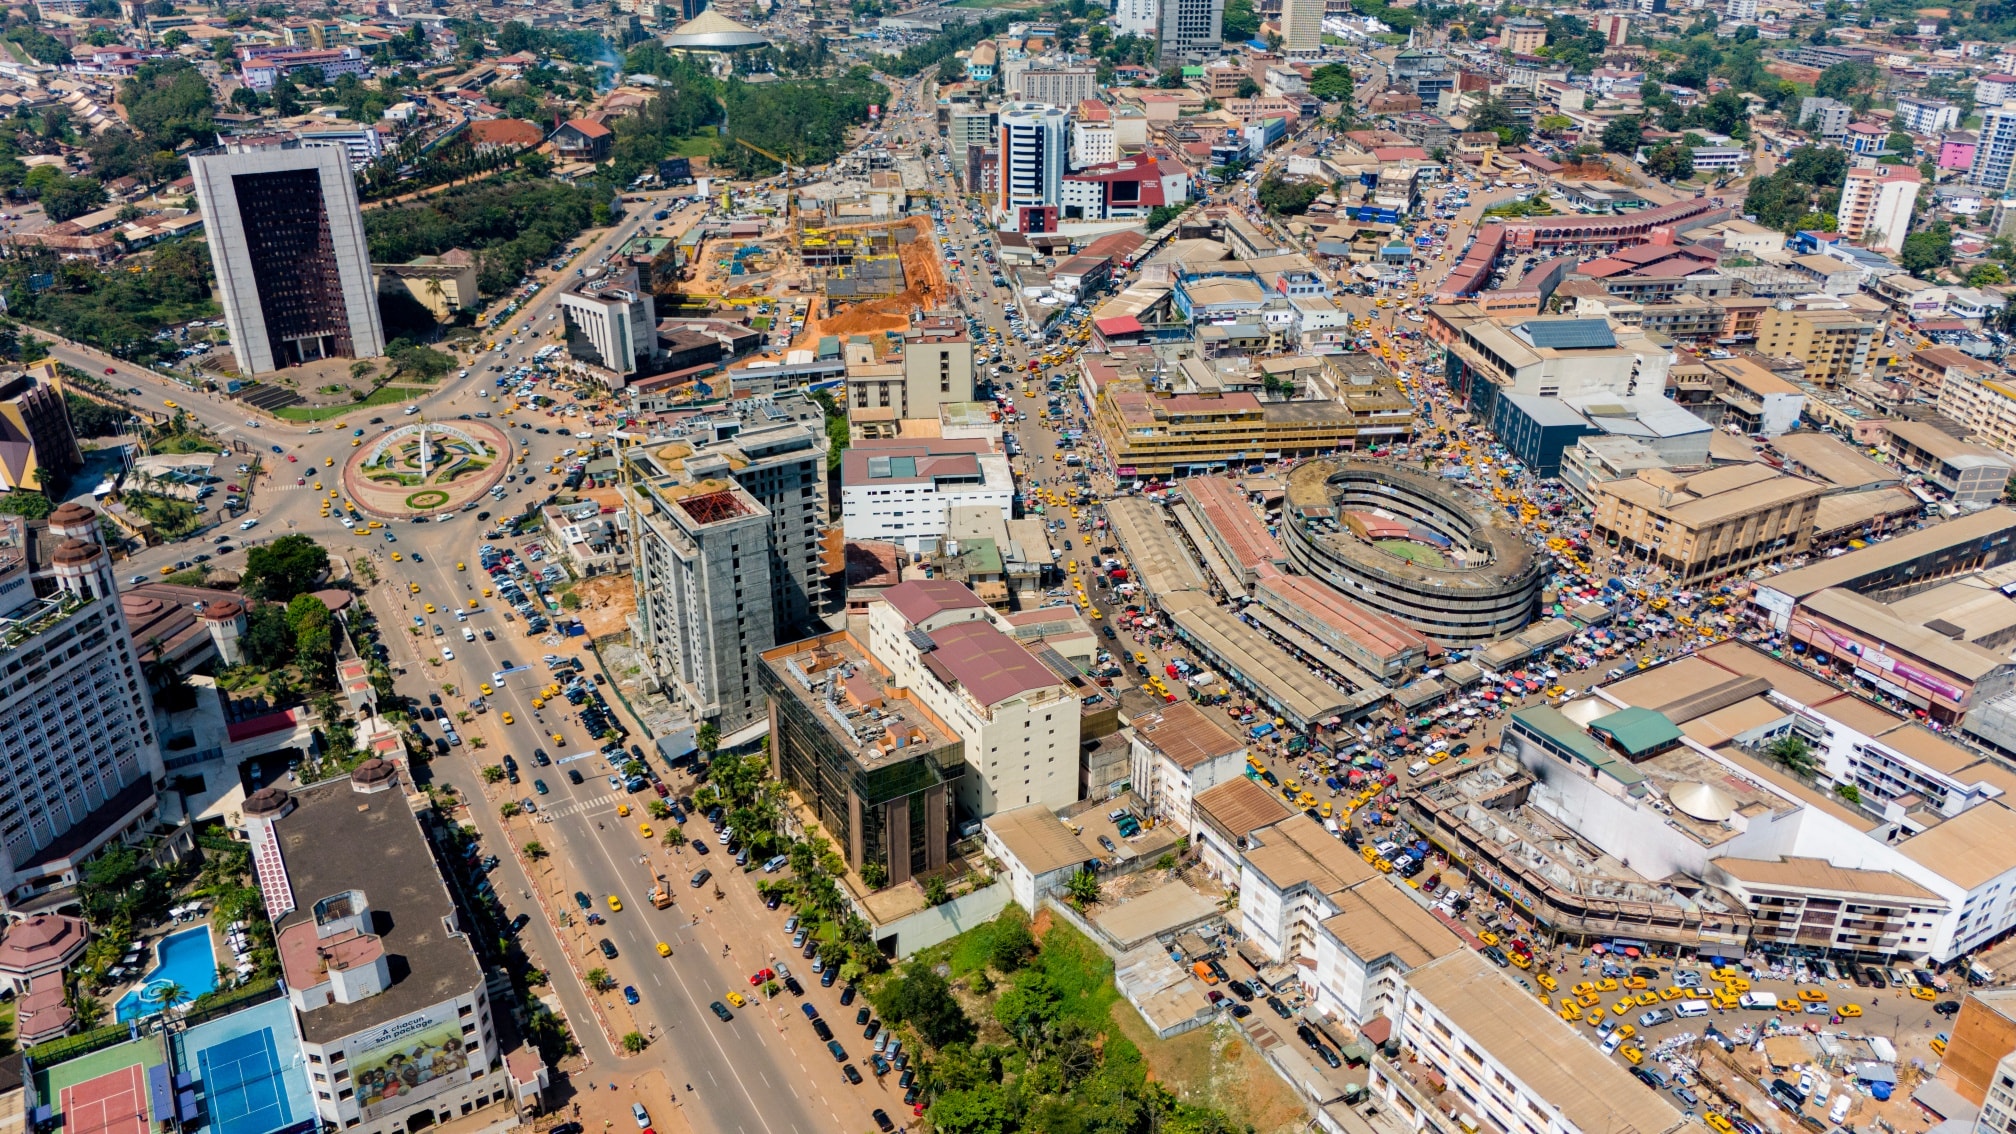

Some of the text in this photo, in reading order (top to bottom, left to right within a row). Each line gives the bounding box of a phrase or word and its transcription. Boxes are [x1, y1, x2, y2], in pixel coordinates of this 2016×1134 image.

[375, 1034, 392, 1045] son
[393, 1018, 433, 1038] package
[382, 1016, 425, 1036] A chacun
